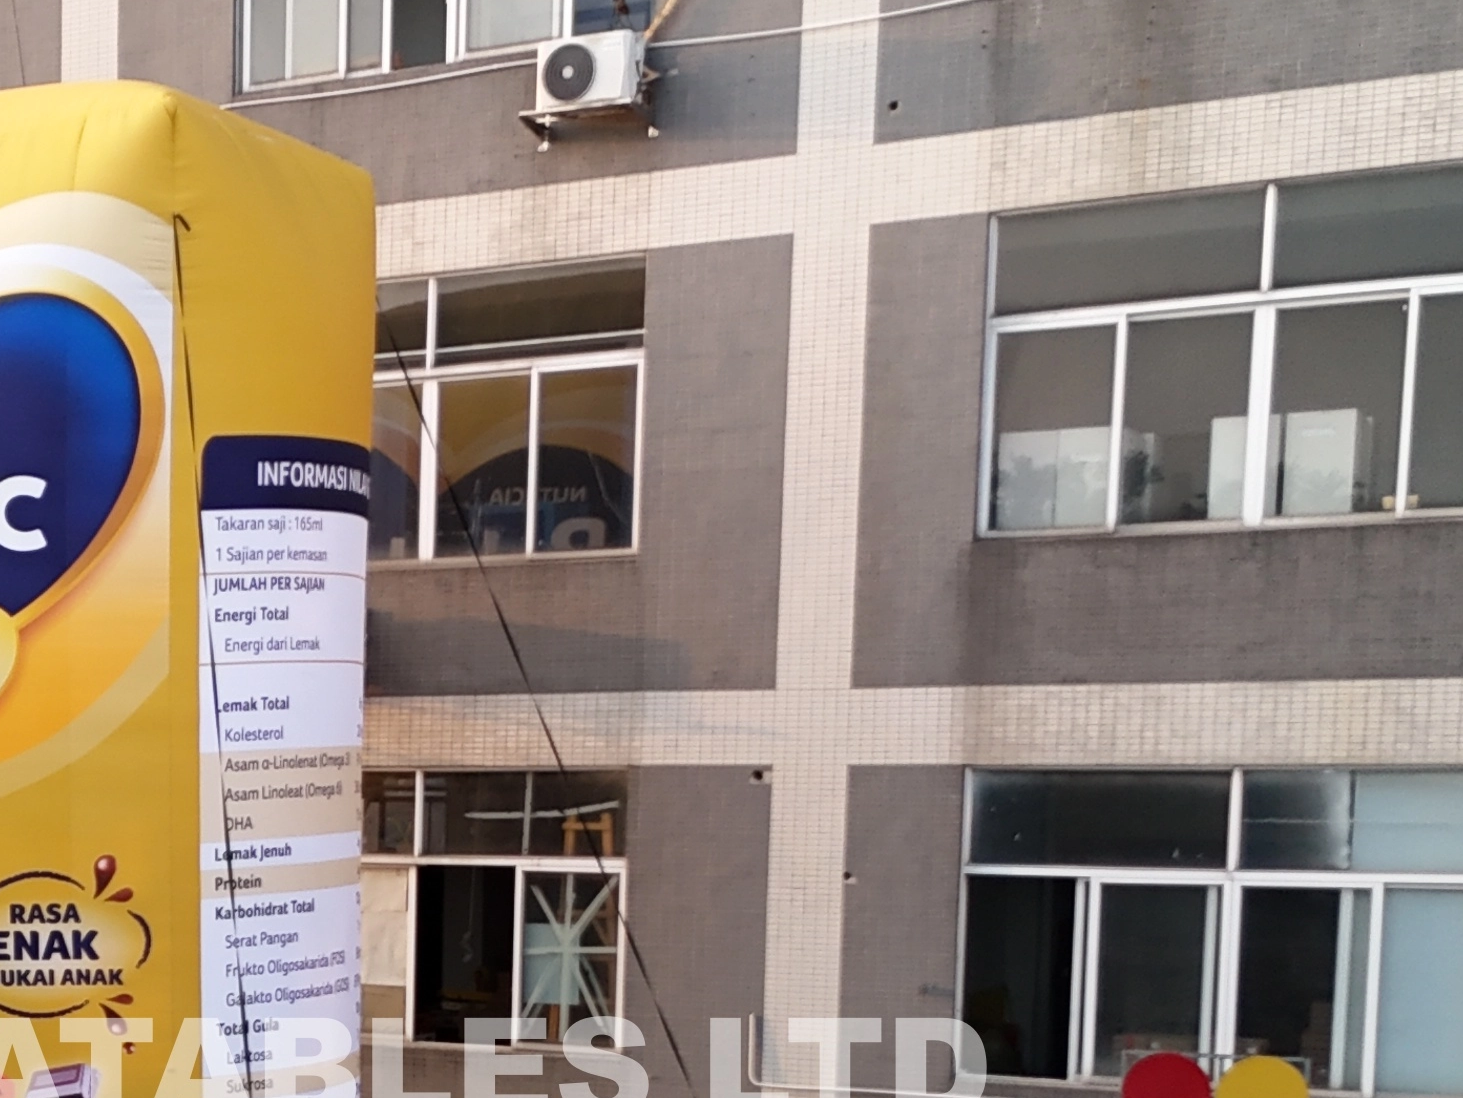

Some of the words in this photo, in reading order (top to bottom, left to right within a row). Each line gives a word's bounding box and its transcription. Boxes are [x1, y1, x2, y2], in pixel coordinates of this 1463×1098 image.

[257, 461, 347, 491] INFORMASI
[215, 516, 264, 532] Takaran
[268, 516, 286, 534] saji
[295, 517, 323, 532] 165ml
[216, 547, 222, 562] 1
[226, 547, 263, 565] Sajian
[267, 550, 286, 564] per
[287, 545, 327, 561] kemasan
[213, 577, 267, 596] JUMLAH
[271, 575, 291, 591] PER
[294, 576, 324, 594] SAJIAN
[214, 606, 256, 625] Energi
[260, 606, 289, 622] Total
[224, 637, 263, 655] Energi
[267, 636, 287, 651] dari
[290, 636, 320, 651] Lemak
[261, 696, 290, 711] Total
[224, 726, 284, 742] Kolesterol
[224, 758, 259, 772] Asam
[225, 788, 259, 801] Asam
[262, 784, 303, 799] Linoleat
[226, 816, 253, 832] DHA
[259, 842, 292, 862] Jenuh
[215, 874, 262, 891] Protein
[10, 903, 81, 924] RASA
[215, 903, 288, 920] Karbohidrat
[291, 897, 315, 914] Total
[225, 934, 257, 949] Serat
[260, 931, 298, 948] Pangan
[60, 968, 123, 986] ANAK
[226, 962, 264, 978] Frukto
[252, 1018, 279, 1033] Gula
